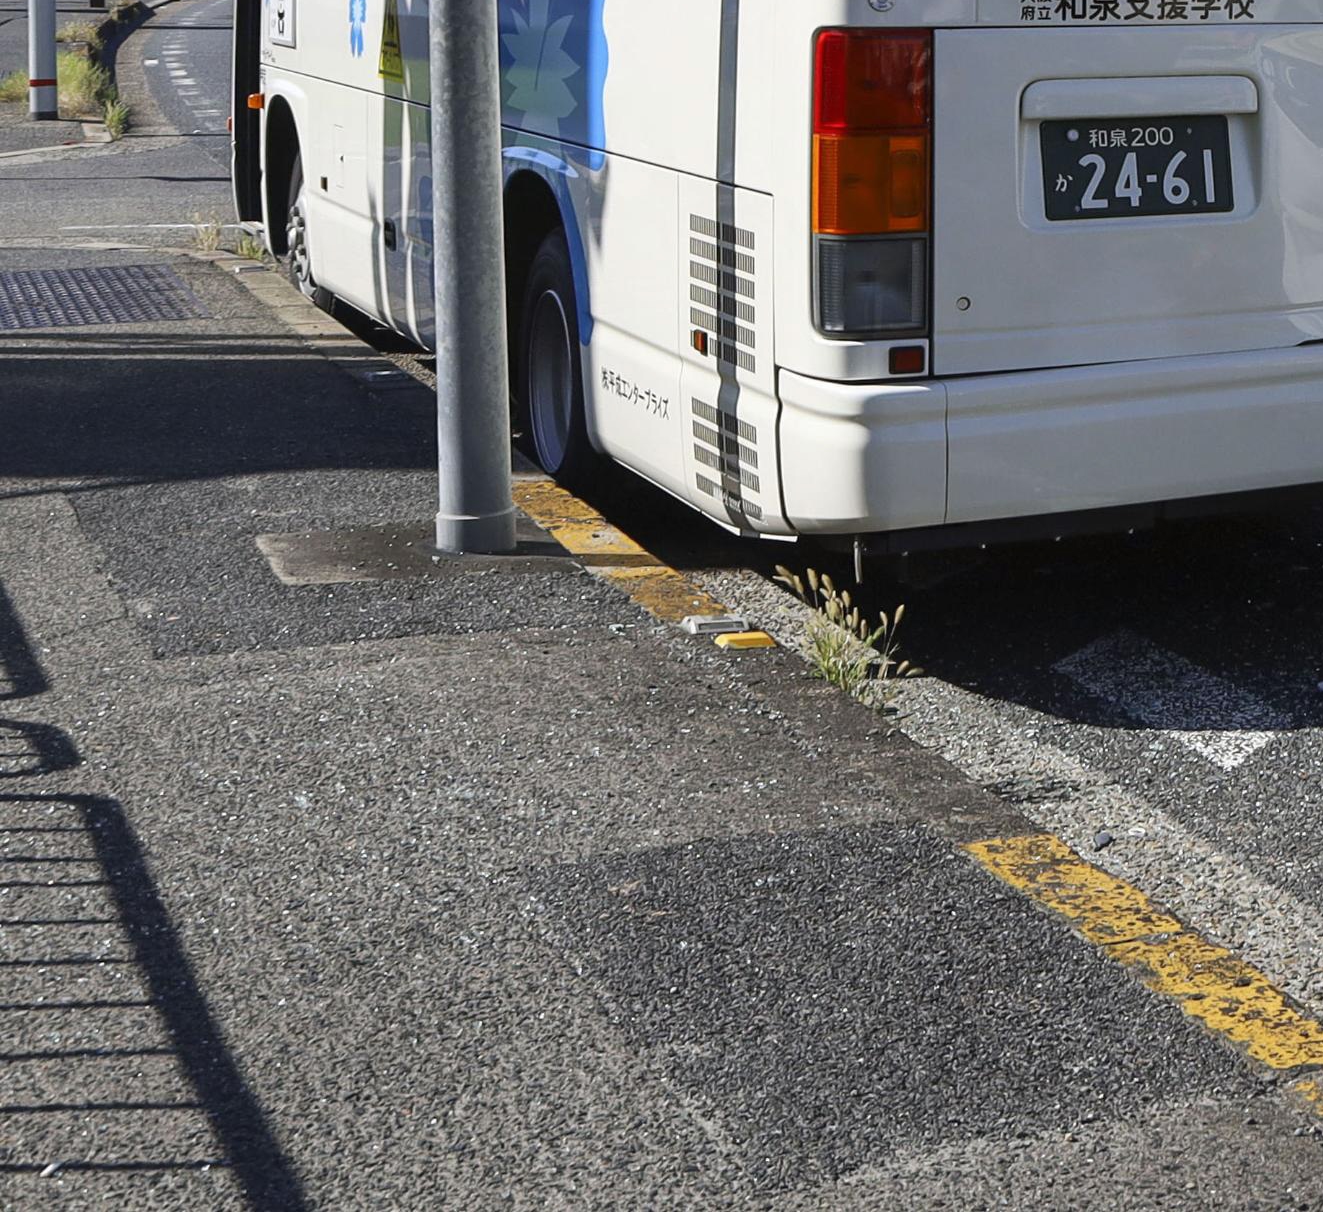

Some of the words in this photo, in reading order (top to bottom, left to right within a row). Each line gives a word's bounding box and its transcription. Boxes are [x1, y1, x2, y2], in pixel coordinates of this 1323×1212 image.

[1020, 5, 1052, 21] 府立
[1055, 172, 1074, 195] か
[1079, 148, 1217, 211] 24-61
